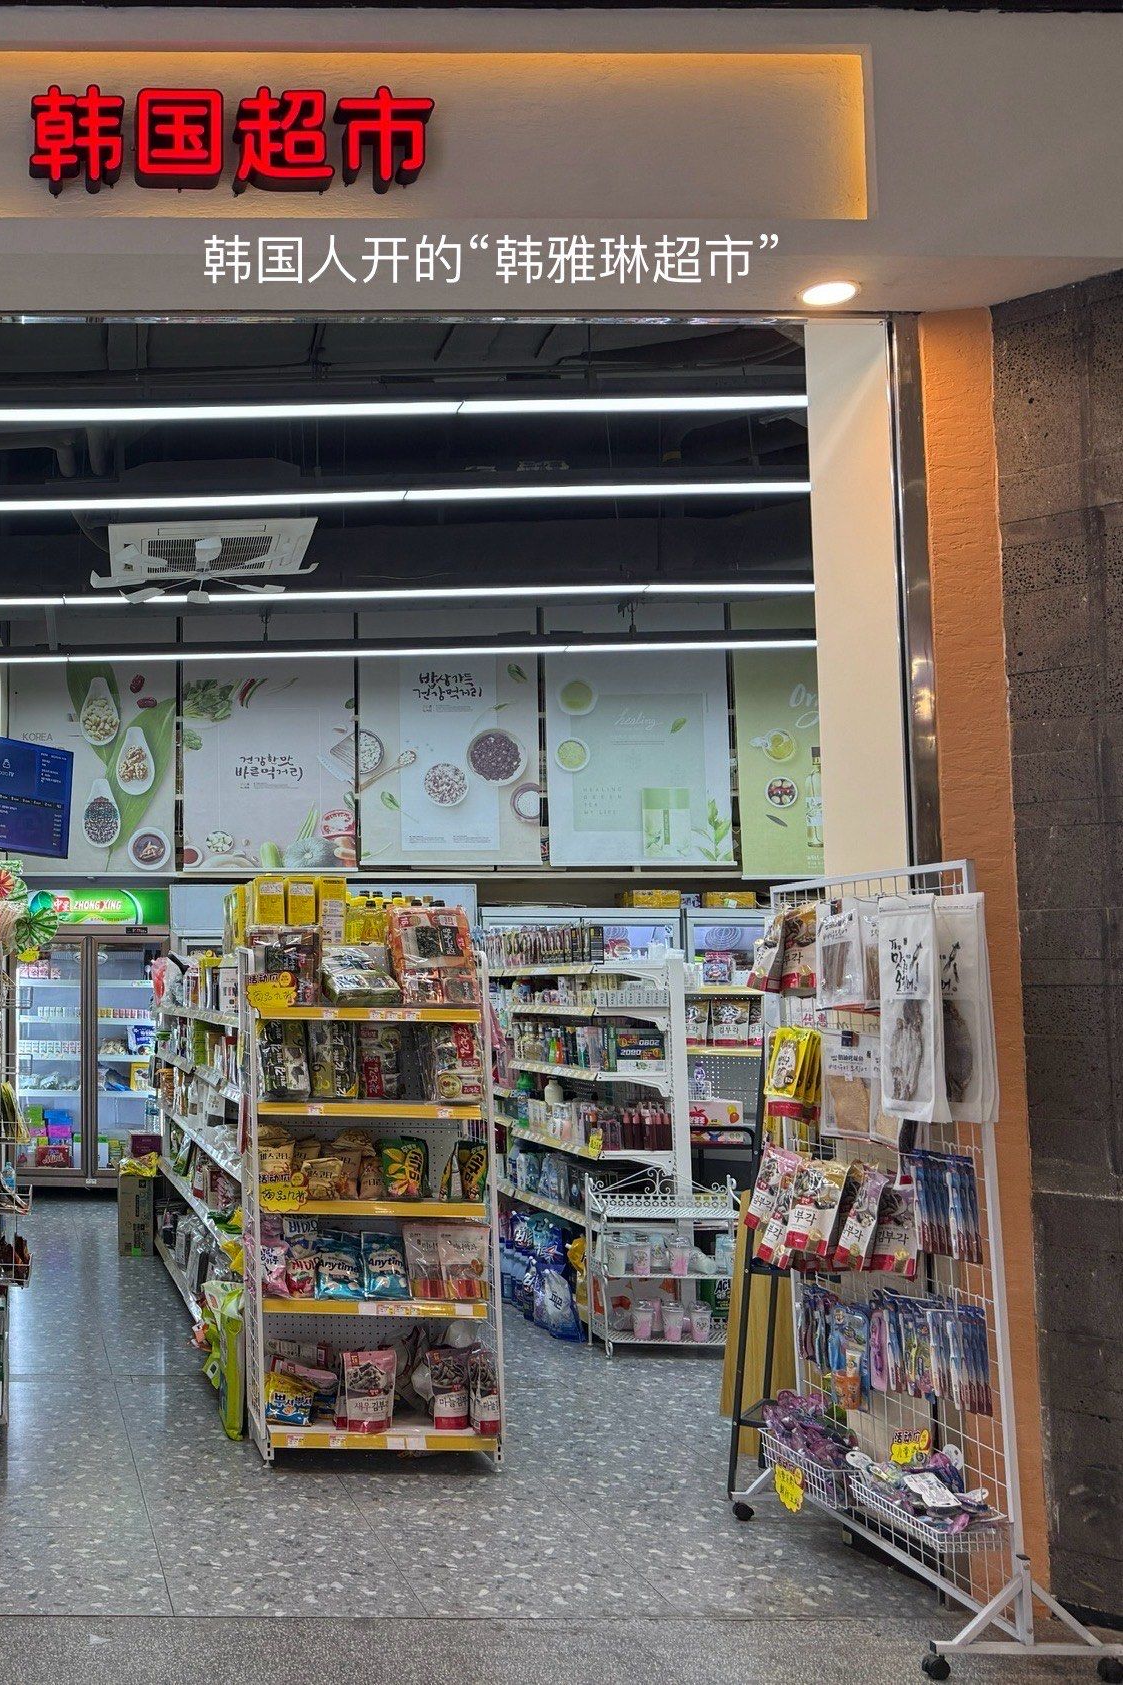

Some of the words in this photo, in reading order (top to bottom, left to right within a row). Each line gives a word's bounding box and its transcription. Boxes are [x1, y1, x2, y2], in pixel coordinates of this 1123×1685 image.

[32, 86, 435, 181] 韩国超市
[23, 732, 53, 742] KOREA
[235, 766, 303, 781] 바른먹거리
